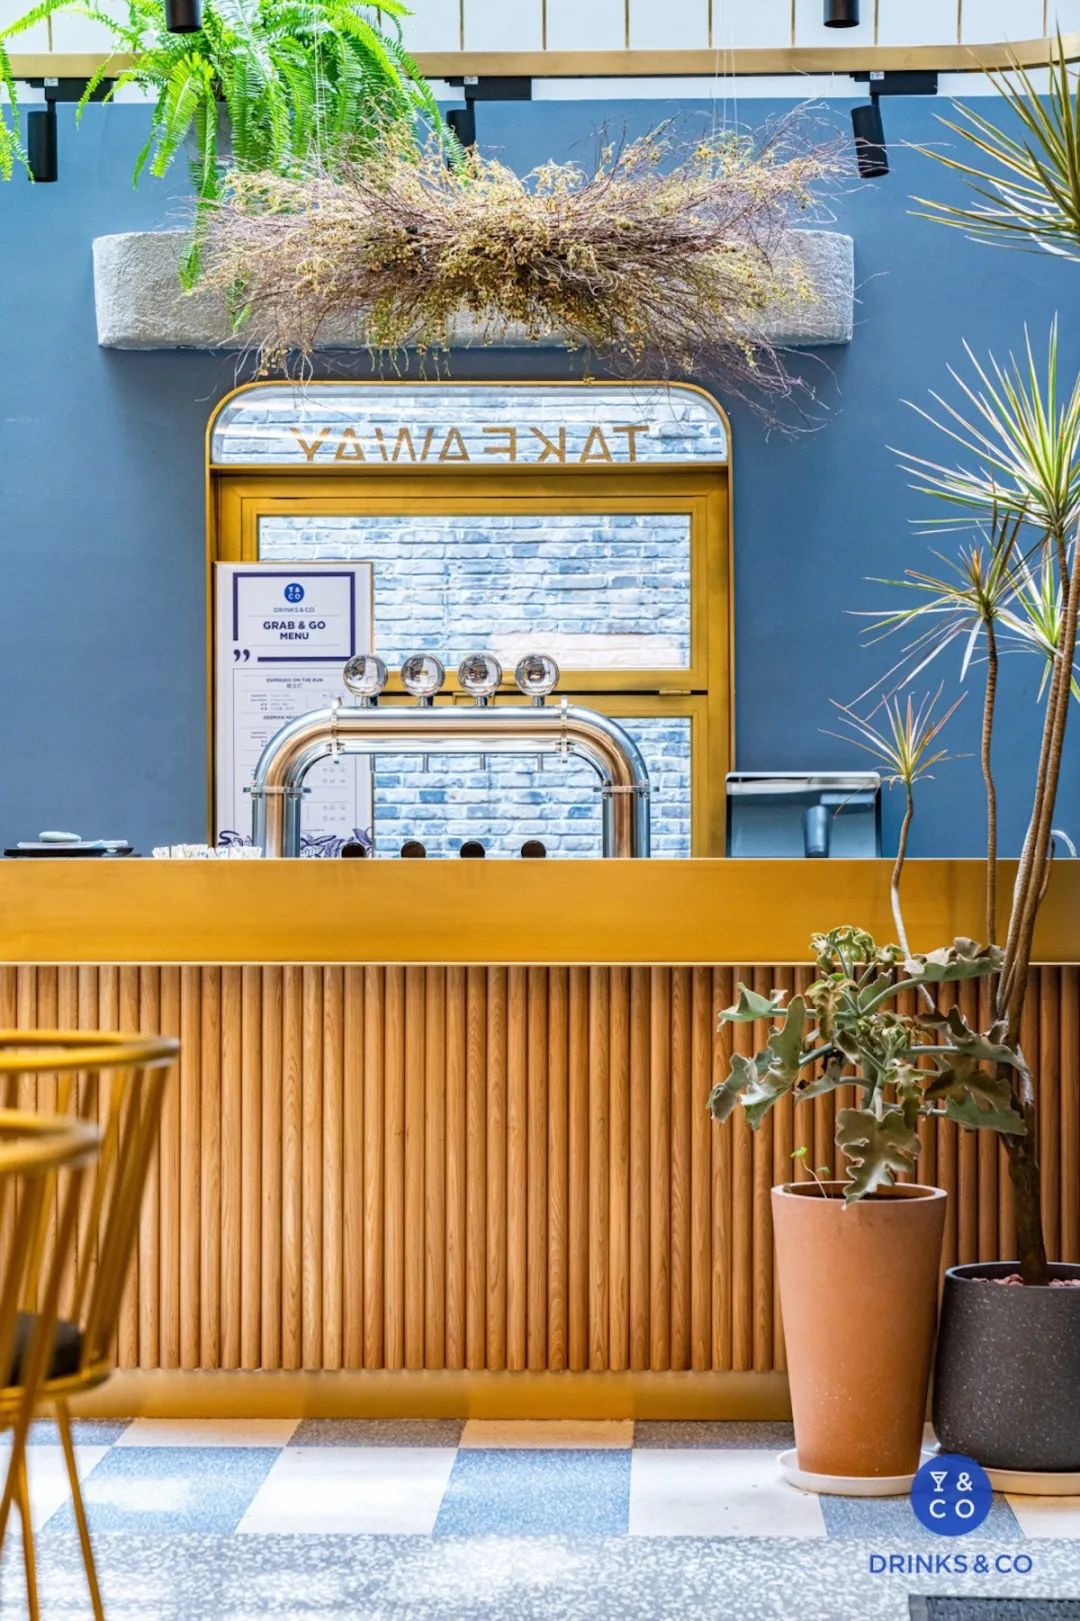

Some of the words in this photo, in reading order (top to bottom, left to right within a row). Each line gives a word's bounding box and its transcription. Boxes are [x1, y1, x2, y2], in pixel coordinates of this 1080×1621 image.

[263, 621, 295, 630] GRAB
[298, 621, 306, 630] &
[309, 621, 326, 630] GO
[280, 632, 310, 640] MENU
